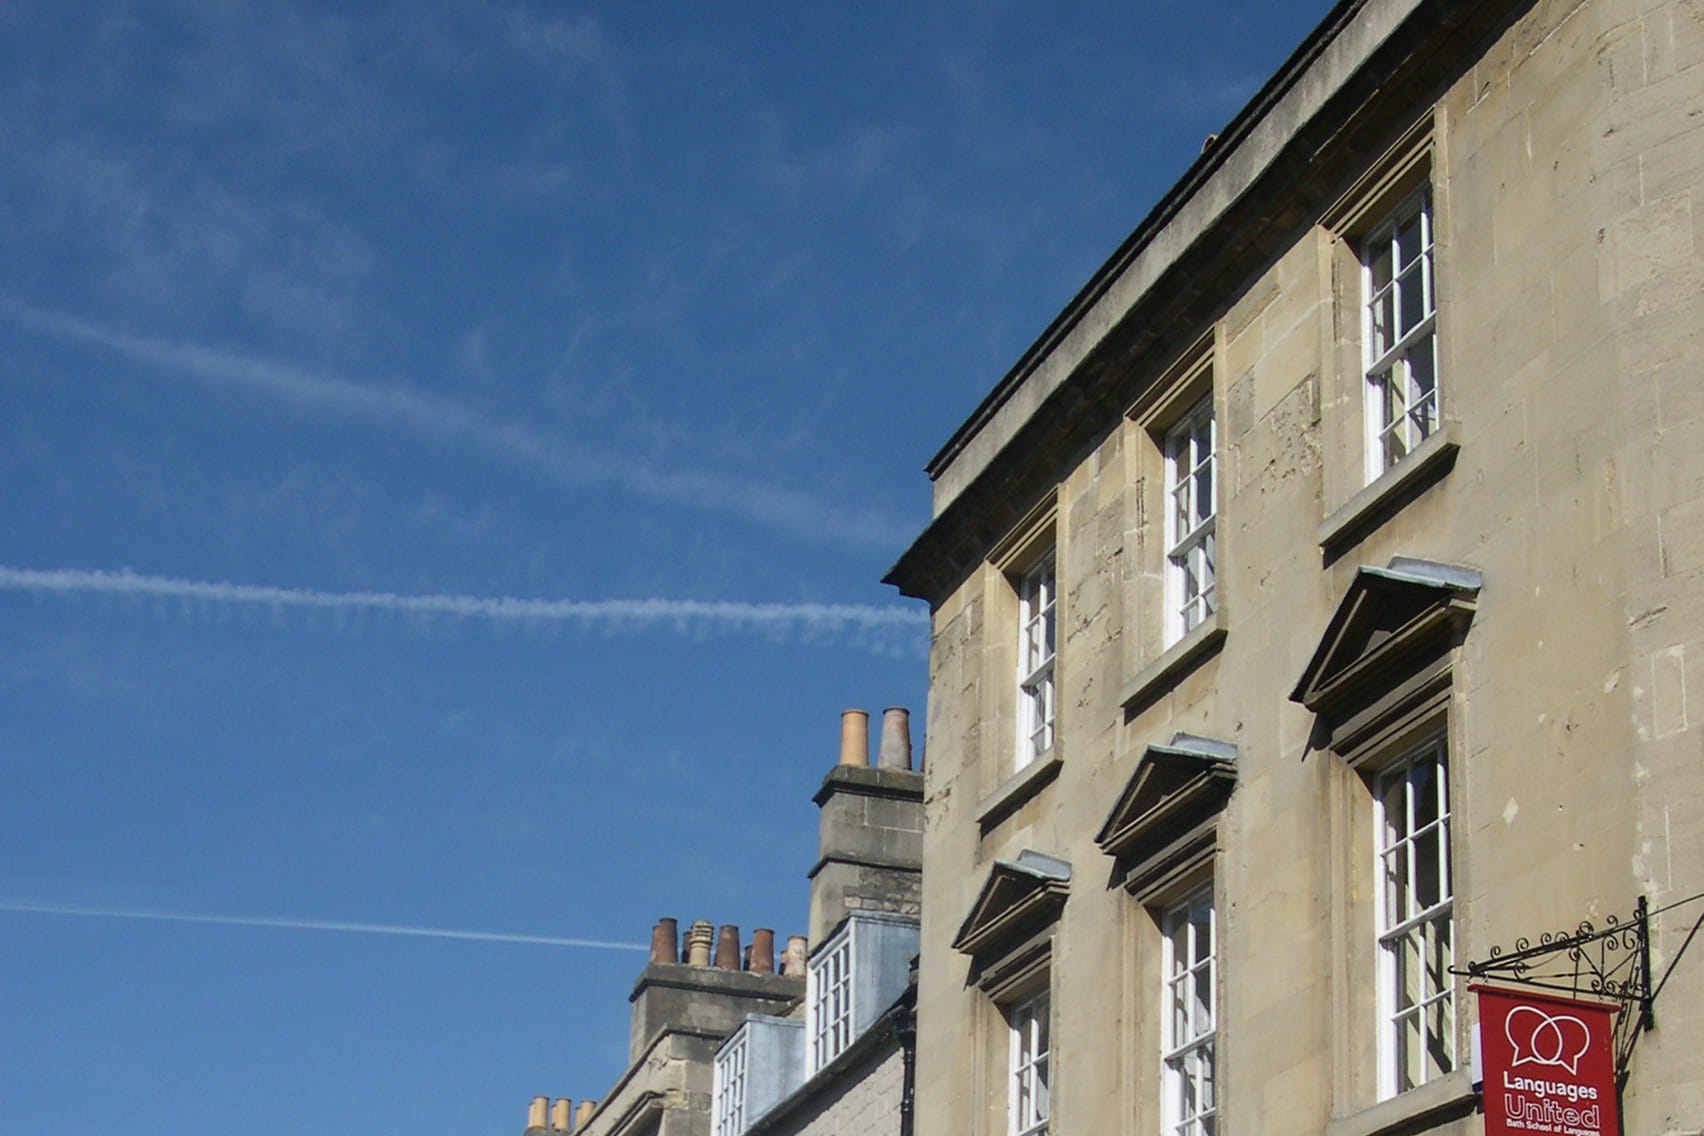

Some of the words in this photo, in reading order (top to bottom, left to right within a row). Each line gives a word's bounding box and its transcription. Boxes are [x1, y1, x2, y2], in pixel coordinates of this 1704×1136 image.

[1503, 1070, 1598, 1102] Languages
[1504, 1093, 1600, 1129] United
[1506, 1118, 1525, 1128] Bath
[1526, 1120, 1552, 1132] School
[1553, 1124, 1562, 1133] of
